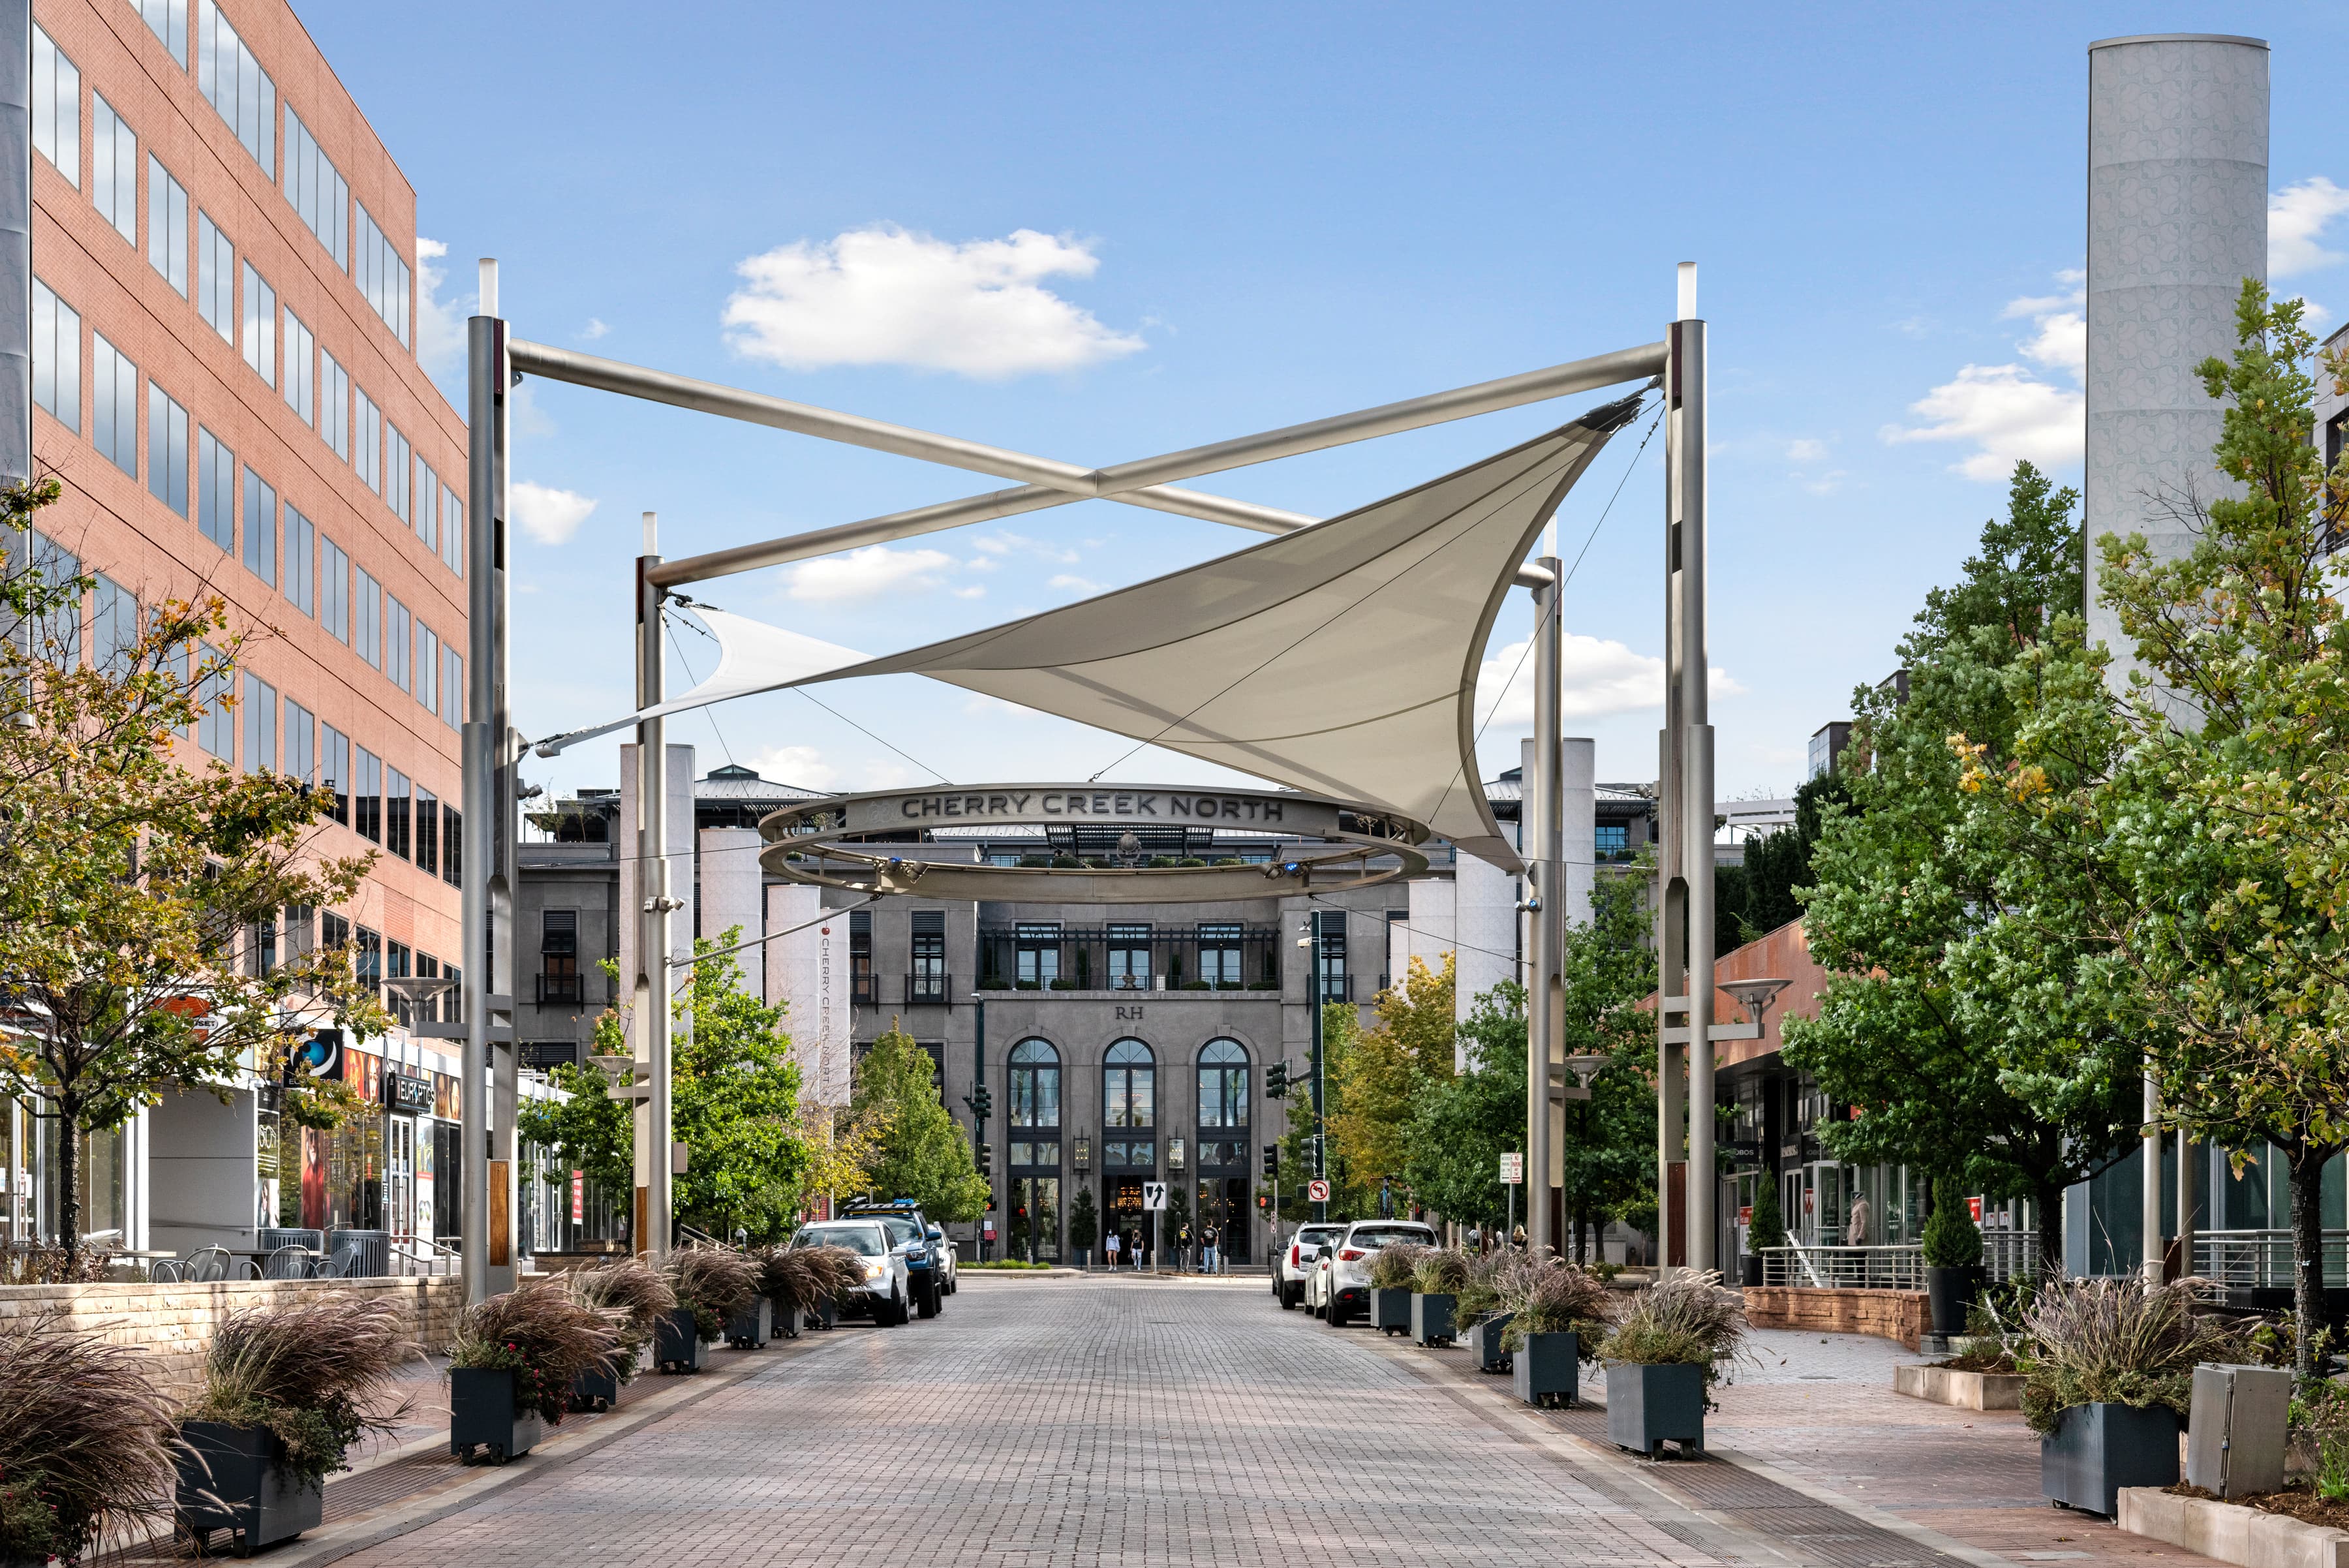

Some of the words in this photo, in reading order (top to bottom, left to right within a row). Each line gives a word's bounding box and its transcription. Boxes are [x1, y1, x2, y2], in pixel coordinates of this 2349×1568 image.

[901, 793, 1030, 818] CHERRY
[1043, 793, 1157, 814] CREEK
[1171, 796, 1283, 821] NORTH
[1115, 1007, 1144, 1019] RH
